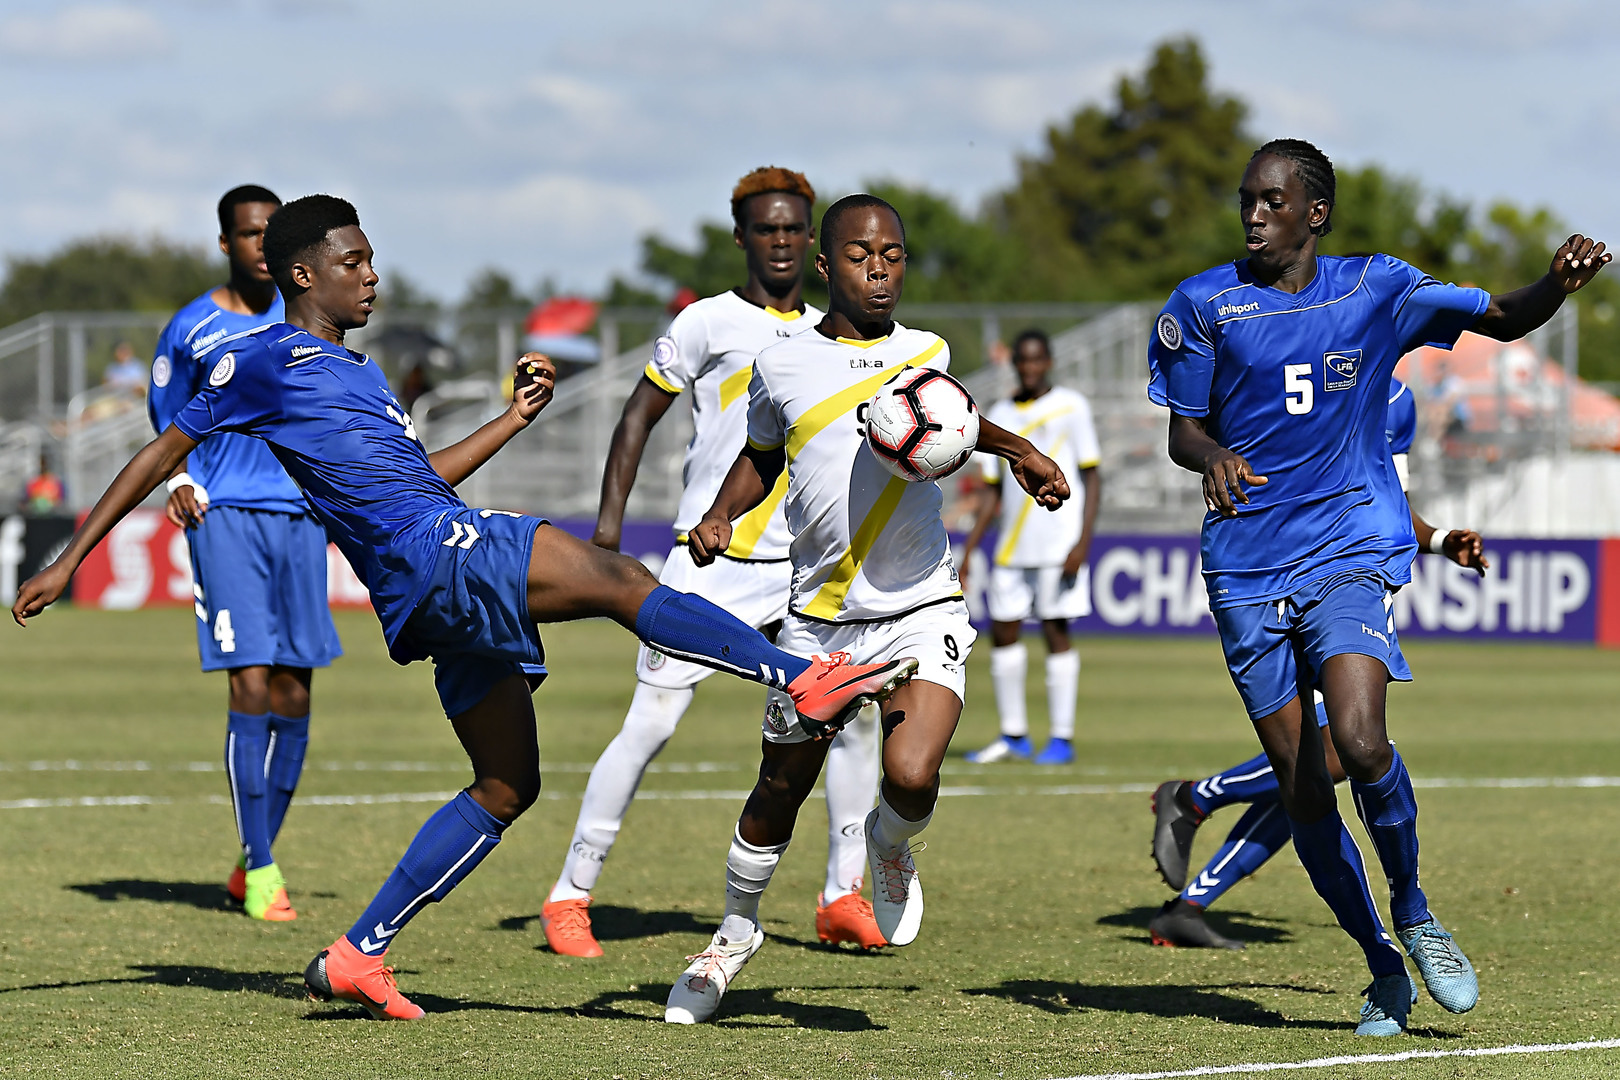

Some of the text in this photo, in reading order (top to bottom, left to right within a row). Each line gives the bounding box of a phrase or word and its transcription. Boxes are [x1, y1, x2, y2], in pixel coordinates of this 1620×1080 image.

[1217, 301, 1260, 316] uhlsport
[849, 359, 884, 369] Lika
[1284, 363, 1314, 415] 5
[213, 608, 236, 653] 4
[943, 633, 960, 662] 9
